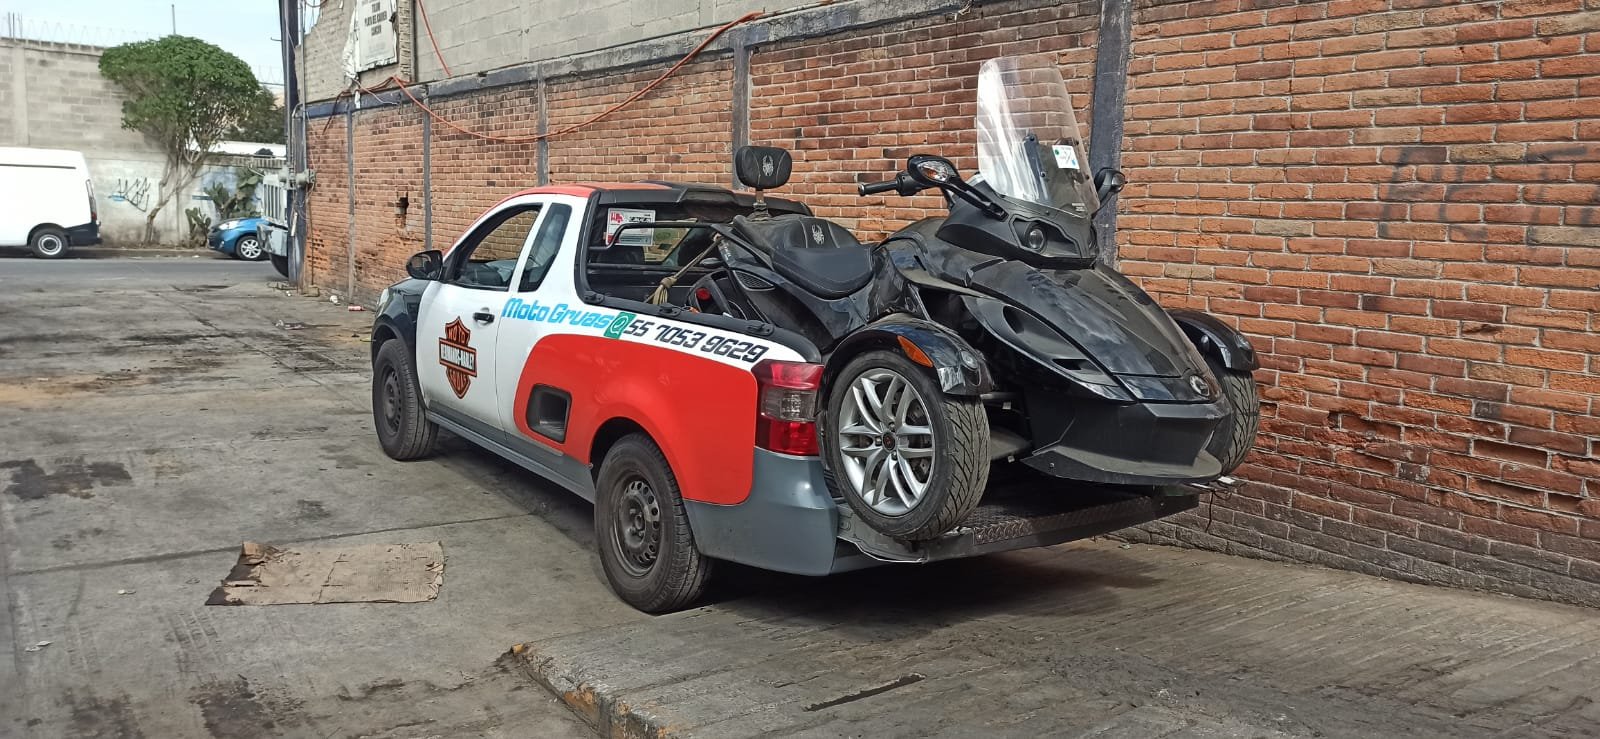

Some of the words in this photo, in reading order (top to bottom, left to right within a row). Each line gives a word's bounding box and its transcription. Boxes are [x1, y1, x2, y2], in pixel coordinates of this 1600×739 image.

[501, 298, 550, 321] Moto
[547, 303, 615, 328] Gruas
[623, 319, 655, 337] 55
[654, 324, 706, 348] 7053
[700, 335, 769, 363] 9629
